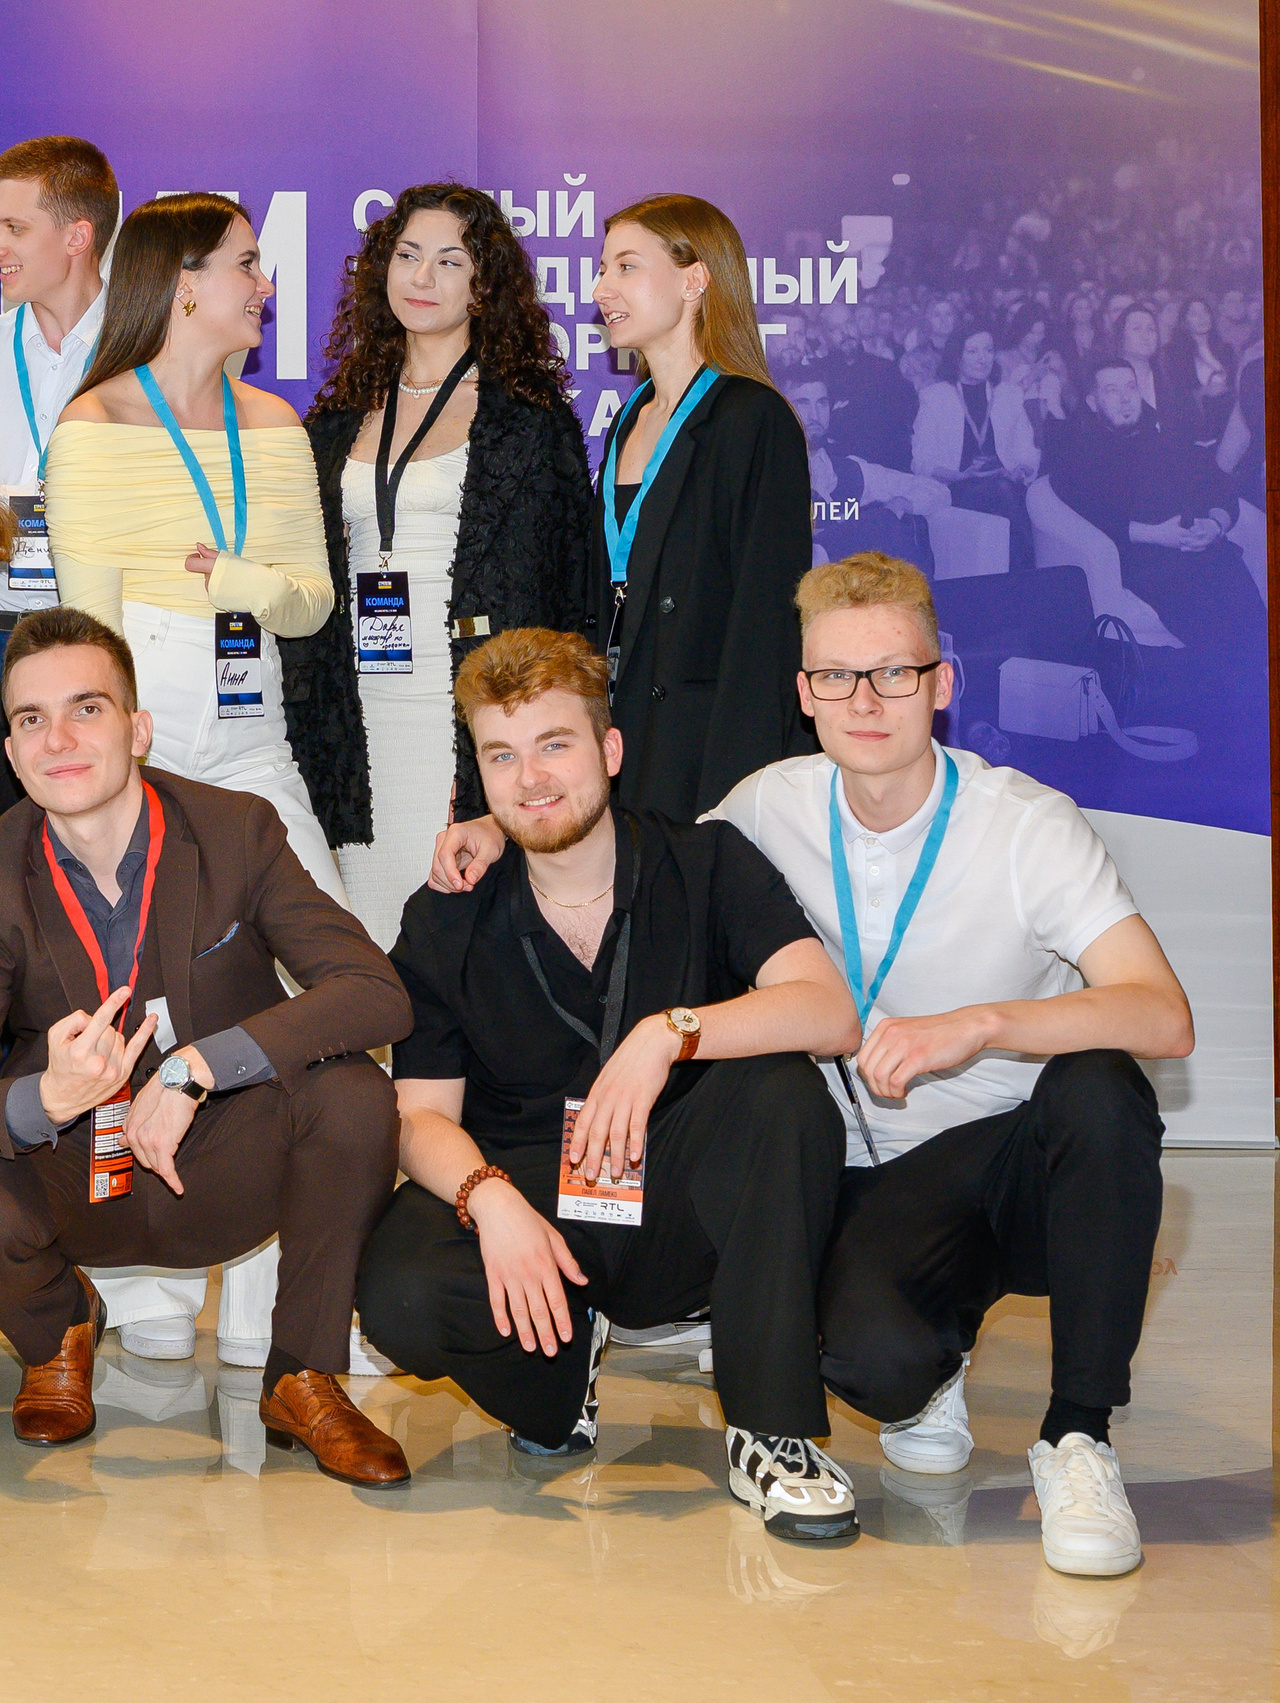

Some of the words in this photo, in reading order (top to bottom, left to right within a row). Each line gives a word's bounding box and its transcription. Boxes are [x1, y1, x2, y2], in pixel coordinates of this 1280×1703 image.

[352, 172, 595, 238] СЫЙ
[365, 597, 405, 608] КОМАНДА
[220, 638, 255, 650] КОМАНДА
[600, 1201, 625, 1212] RTL
